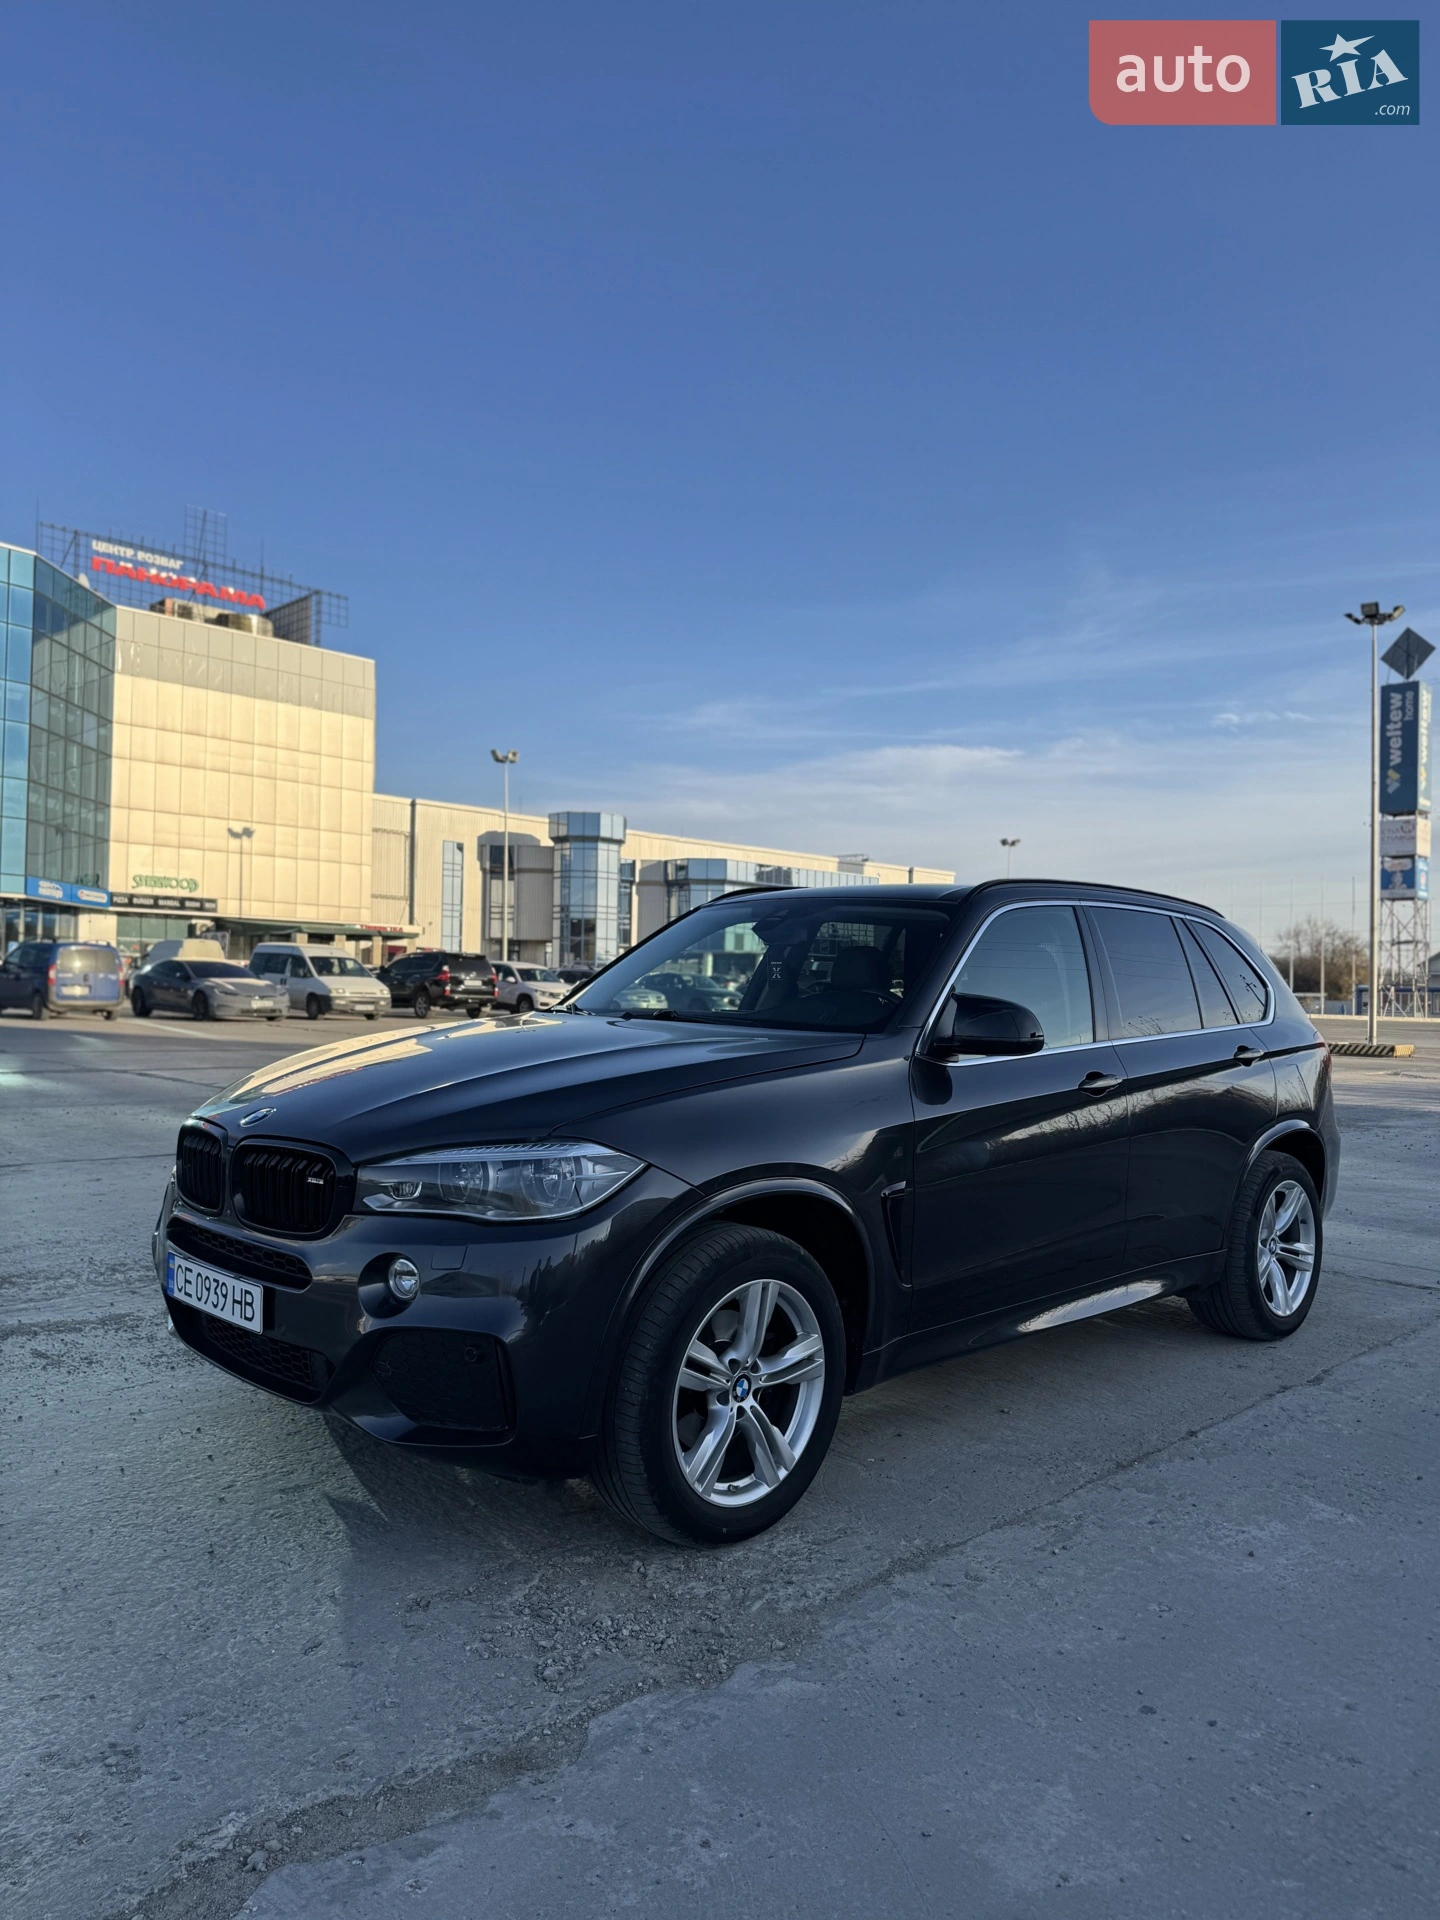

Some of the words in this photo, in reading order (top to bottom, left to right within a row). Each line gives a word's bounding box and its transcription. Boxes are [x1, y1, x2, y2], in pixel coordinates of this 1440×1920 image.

[92, 539, 135, 560] ЦЕНТР
[91, 556, 266, 610] ПАНОРАМА
[1386, 692, 1403, 766] weltew
[113, 895, 129, 904] PIZZA
[176, 1264, 193, 1298] CE
[196, 1272, 228, 1312] 0939
[232, 1285, 255, 1322] HB
